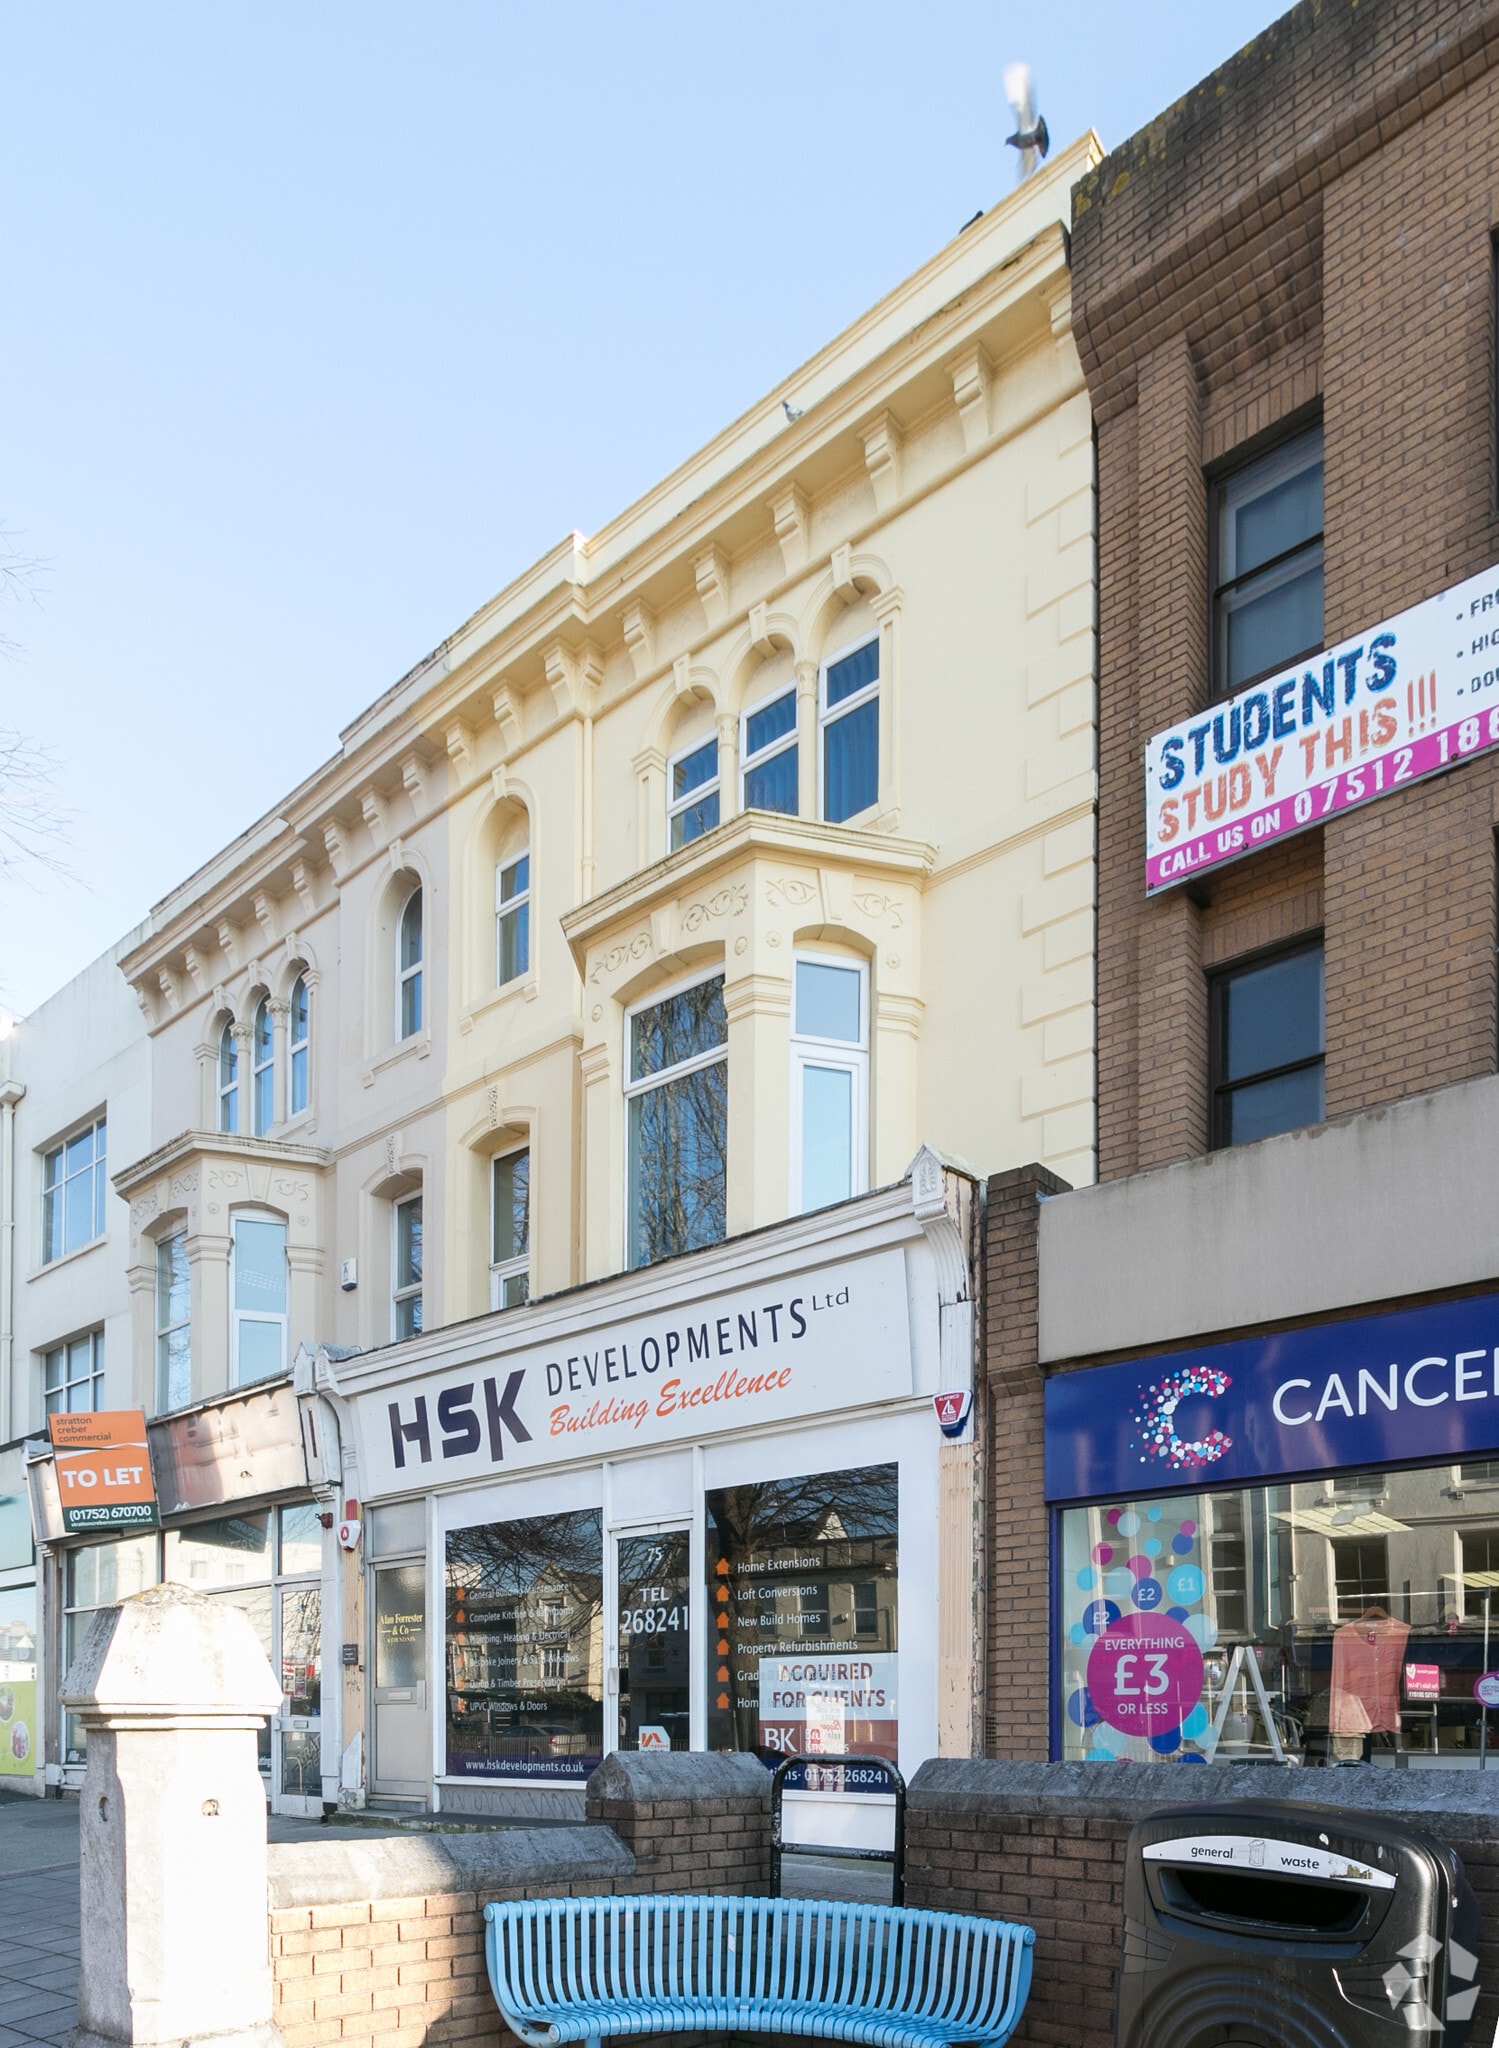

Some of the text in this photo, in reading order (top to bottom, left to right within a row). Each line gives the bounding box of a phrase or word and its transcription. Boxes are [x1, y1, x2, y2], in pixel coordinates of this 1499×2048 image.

[1159, 632, 1398, 791] STUDENTS
[1157, 744, 1284, 843] STUDY
[1159, 841, 1211, 879] CALL
[1217, 825, 1245, 851] US
[1251, 807, 1281, 839] ON
[1293, 747, 1414, 824] 07512
[546, 1286, 849, 1396] DEVELOPMENTS Ltd
[1272, 1347, 1499, 1426] CANCE
[549, 1367, 792, 1436] Building Excellence
[56, 1417, 92, 1425] stratton
[388, 1368, 532, 1469] HSK
[57, 1426, 87, 1434] creber
[58, 1432, 111, 1443] commercial
[61, 1466, 143, 1488] TO LET
[69, 1505, 151, 1522] (01752) 670700
[737, 1557, 820, 1573] Home Extensions
[1177, 1577, 1196, 1592] £1
[469, 1589, 493, 1600] General
[639, 1587, 670, 1602] TEL
[737, 1585, 818, 1600] Loft Conversions
[1138, 1587, 1155, 1601] £2
[395, 1613, 423, 1623] Forrester
[469, 1612, 500, 1624] Complete
[502, 1609, 527, 1619] Kitchen
[528, 1609, 535, 1618] &
[621, 1606, 688, 1634] 268241
[737, 1613, 821, 1627] New Build Homes
[1092, 1612, 1110, 1625] £2
[392, 1624, 409, 1635] & Co
[503, 1633, 530, 1643] Heating
[531, 1632, 537, 1641] &
[1104, 1637, 1184, 1651] EVERYTHING
[737, 1640, 858, 1655] Property Refurbishments
[497, 1655, 521, 1667] Joinery
[522, 1655, 528, 1665] &
[737, 1669, 759, 1681] Grad
[779, 1662, 873, 1682] ACQUIRED
[1113, 1653, 1169, 1695] £3
[490, 1679, 495, 1688] &
[498, 1678, 521, 1688] Timber
[523, 1677, 566, 1687] Preservation
[469, 1701, 548, 1711] UPVC Windows & Doors
[737, 1697, 759, 1708] Hom
[773, 1691, 805, 1708] FOR
[1117, 1702, 1168, 1714] OR LESS
[764, 1727, 797, 1753] BK
[465, 1760, 584, 1773] www.hskdevelopments.co.uk
[804, 1768, 840, 1781] 01752
[845, 1769, 888, 1784] 268241
[1190, 1847, 1320, 1869] general waste
